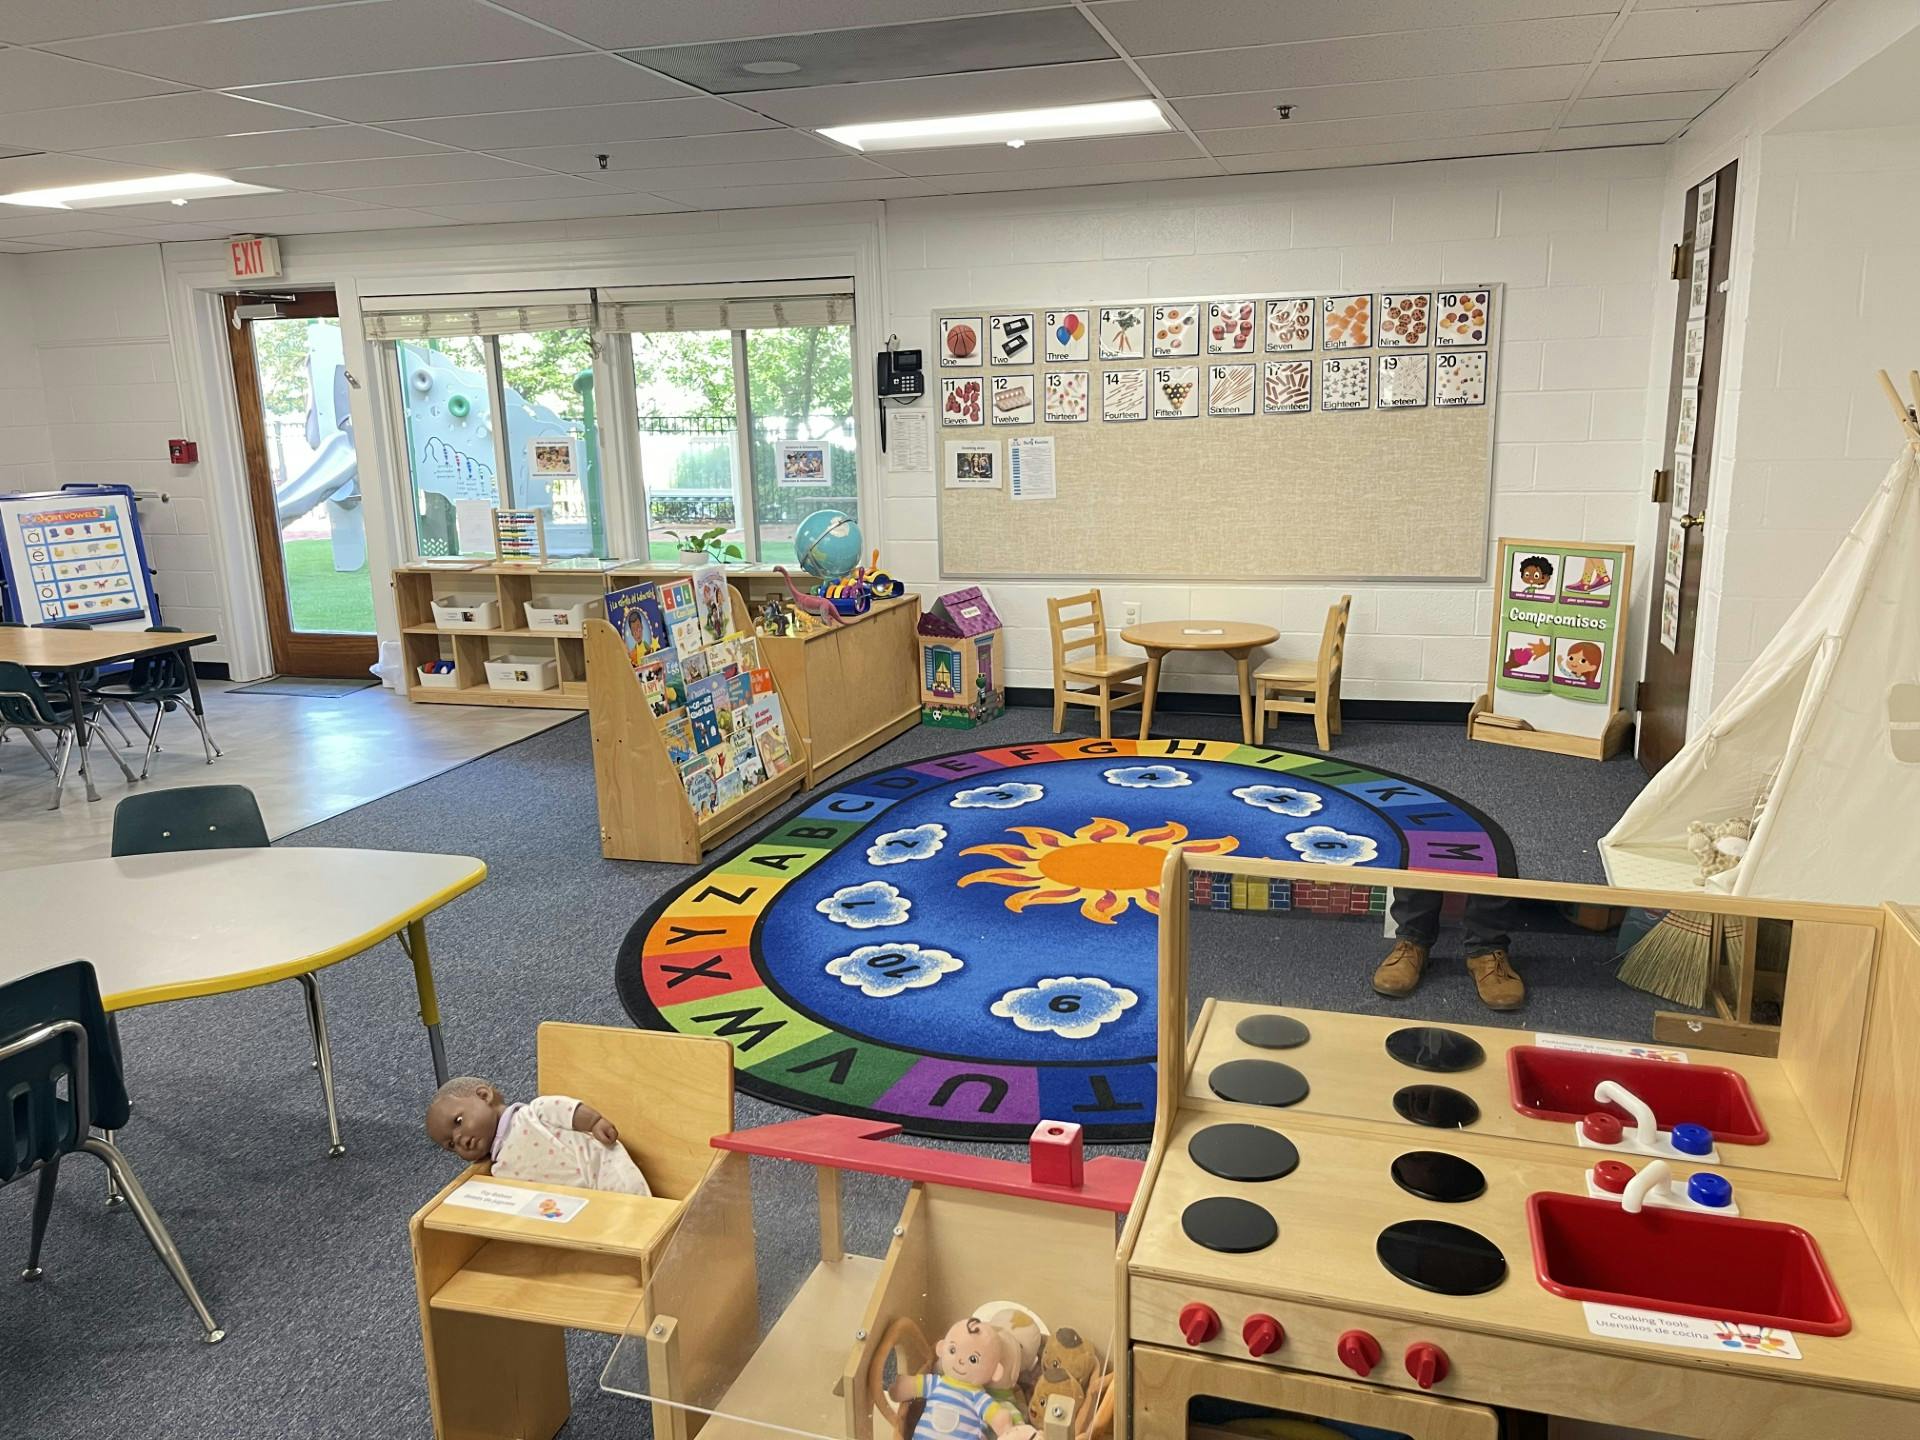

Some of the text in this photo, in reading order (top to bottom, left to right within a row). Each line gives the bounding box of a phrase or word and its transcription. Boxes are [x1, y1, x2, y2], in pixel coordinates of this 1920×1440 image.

[232, 240, 264, 275] EXIT
[1325, 300, 1335, 312] 8
[1383, 296, 1392, 309] 9
[1440, 294, 1457, 308] 10
[1155, 308, 1164, 321] 5
[1211, 305, 1220, 317] 6
[1268, 303, 1278, 315] 7
[1047, 314, 1056, 326] 3
[1102, 311, 1110, 322] 4
[943, 321, 949, 331] 1
[992, 318, 1001, 330] 2
[1325, 340, 1347, 349] Eight
[1380, 338, 1400, 346] Nine
[1438, 336, 1454, 345] Ten
[1154, 347, 1171, 355] Five
[1267, 343, 1293, 351] Seven
[942, 358, 957, 366] One
[993, 356, 1008, 364] Two
[1047, 352, 1069, 360] Three
[1438, 355, 1457, 368] 20
[1326, 361, 1341, 373] 18
[1383, 357, 1398, 370] 19
[1156, 370, 1170, 382] 15
[1212, 368, 1227, 379] 16
[1266, 364, 1282, 376] 17
[994, 378, 1007, 390] 12
[1048, 375, 1062, 387] 13
[1105, 374, 1119, 385] 14
[945, 381, 956, 392] 11
[1324, 400, 1360, 409] Eighteen
[1437, 395, 1469, 405] Twenty
[1155, 409, 1182, 417] Fifteen
[1210, 405, 1240, 414] Sixteen
[1265, 403, 1309, 411] Seventeen
[944, 416, 968, 425] Eleven
[994, 415, 1020, 423] Twelve
[1046, 412, 1077, 421] Thirteen
[1105, 411, 1140, 419] Fourteen
[63, 510, 98, 519] VOWELS
[1509, 607, 1607, 629] Compromisos
[1079, 741, 1119, 754] G
[1164, 740, 1207, 755] H
[1009, 748, 1040, 760] F
[1256, 754, 1284, 764] I
[935, 760, 978, 772] E
[1137, 773, 1160, 781] 4
[1310, 769, 1361, 778] J
[871, 776, 919, 789] D
[987, 791, 1014, 800] 3
[1265, 795, 1297, 804] 5
[1365, 787, 1422, 802] K
[829, 800, 874, 813] C
[1405, 812, 1454, 825] L
[787, 827, 838, 840] B
[886, 839, 919, 849] 2
[1427, 842, 1483, 861] M
[749, 852, 806, 871] A
[692, 886, 758, 904] Z
[841, 901, 875, 909] 1
[666, 926, 727, 945] Y
[660, 955, 732, 988] X
[868, 953, 920, 979] 10
[691, 1007, 788, 1052] W
[787, 1048, 858, 1084] V
[929, 1073, 1009, 1113] U
[1072, 1076, 1143, 1112] T
[1609, 1312, 1689, 1328] Cooking Tools
[1596, 1320, 1710, 1340] Utensilios de cocina
